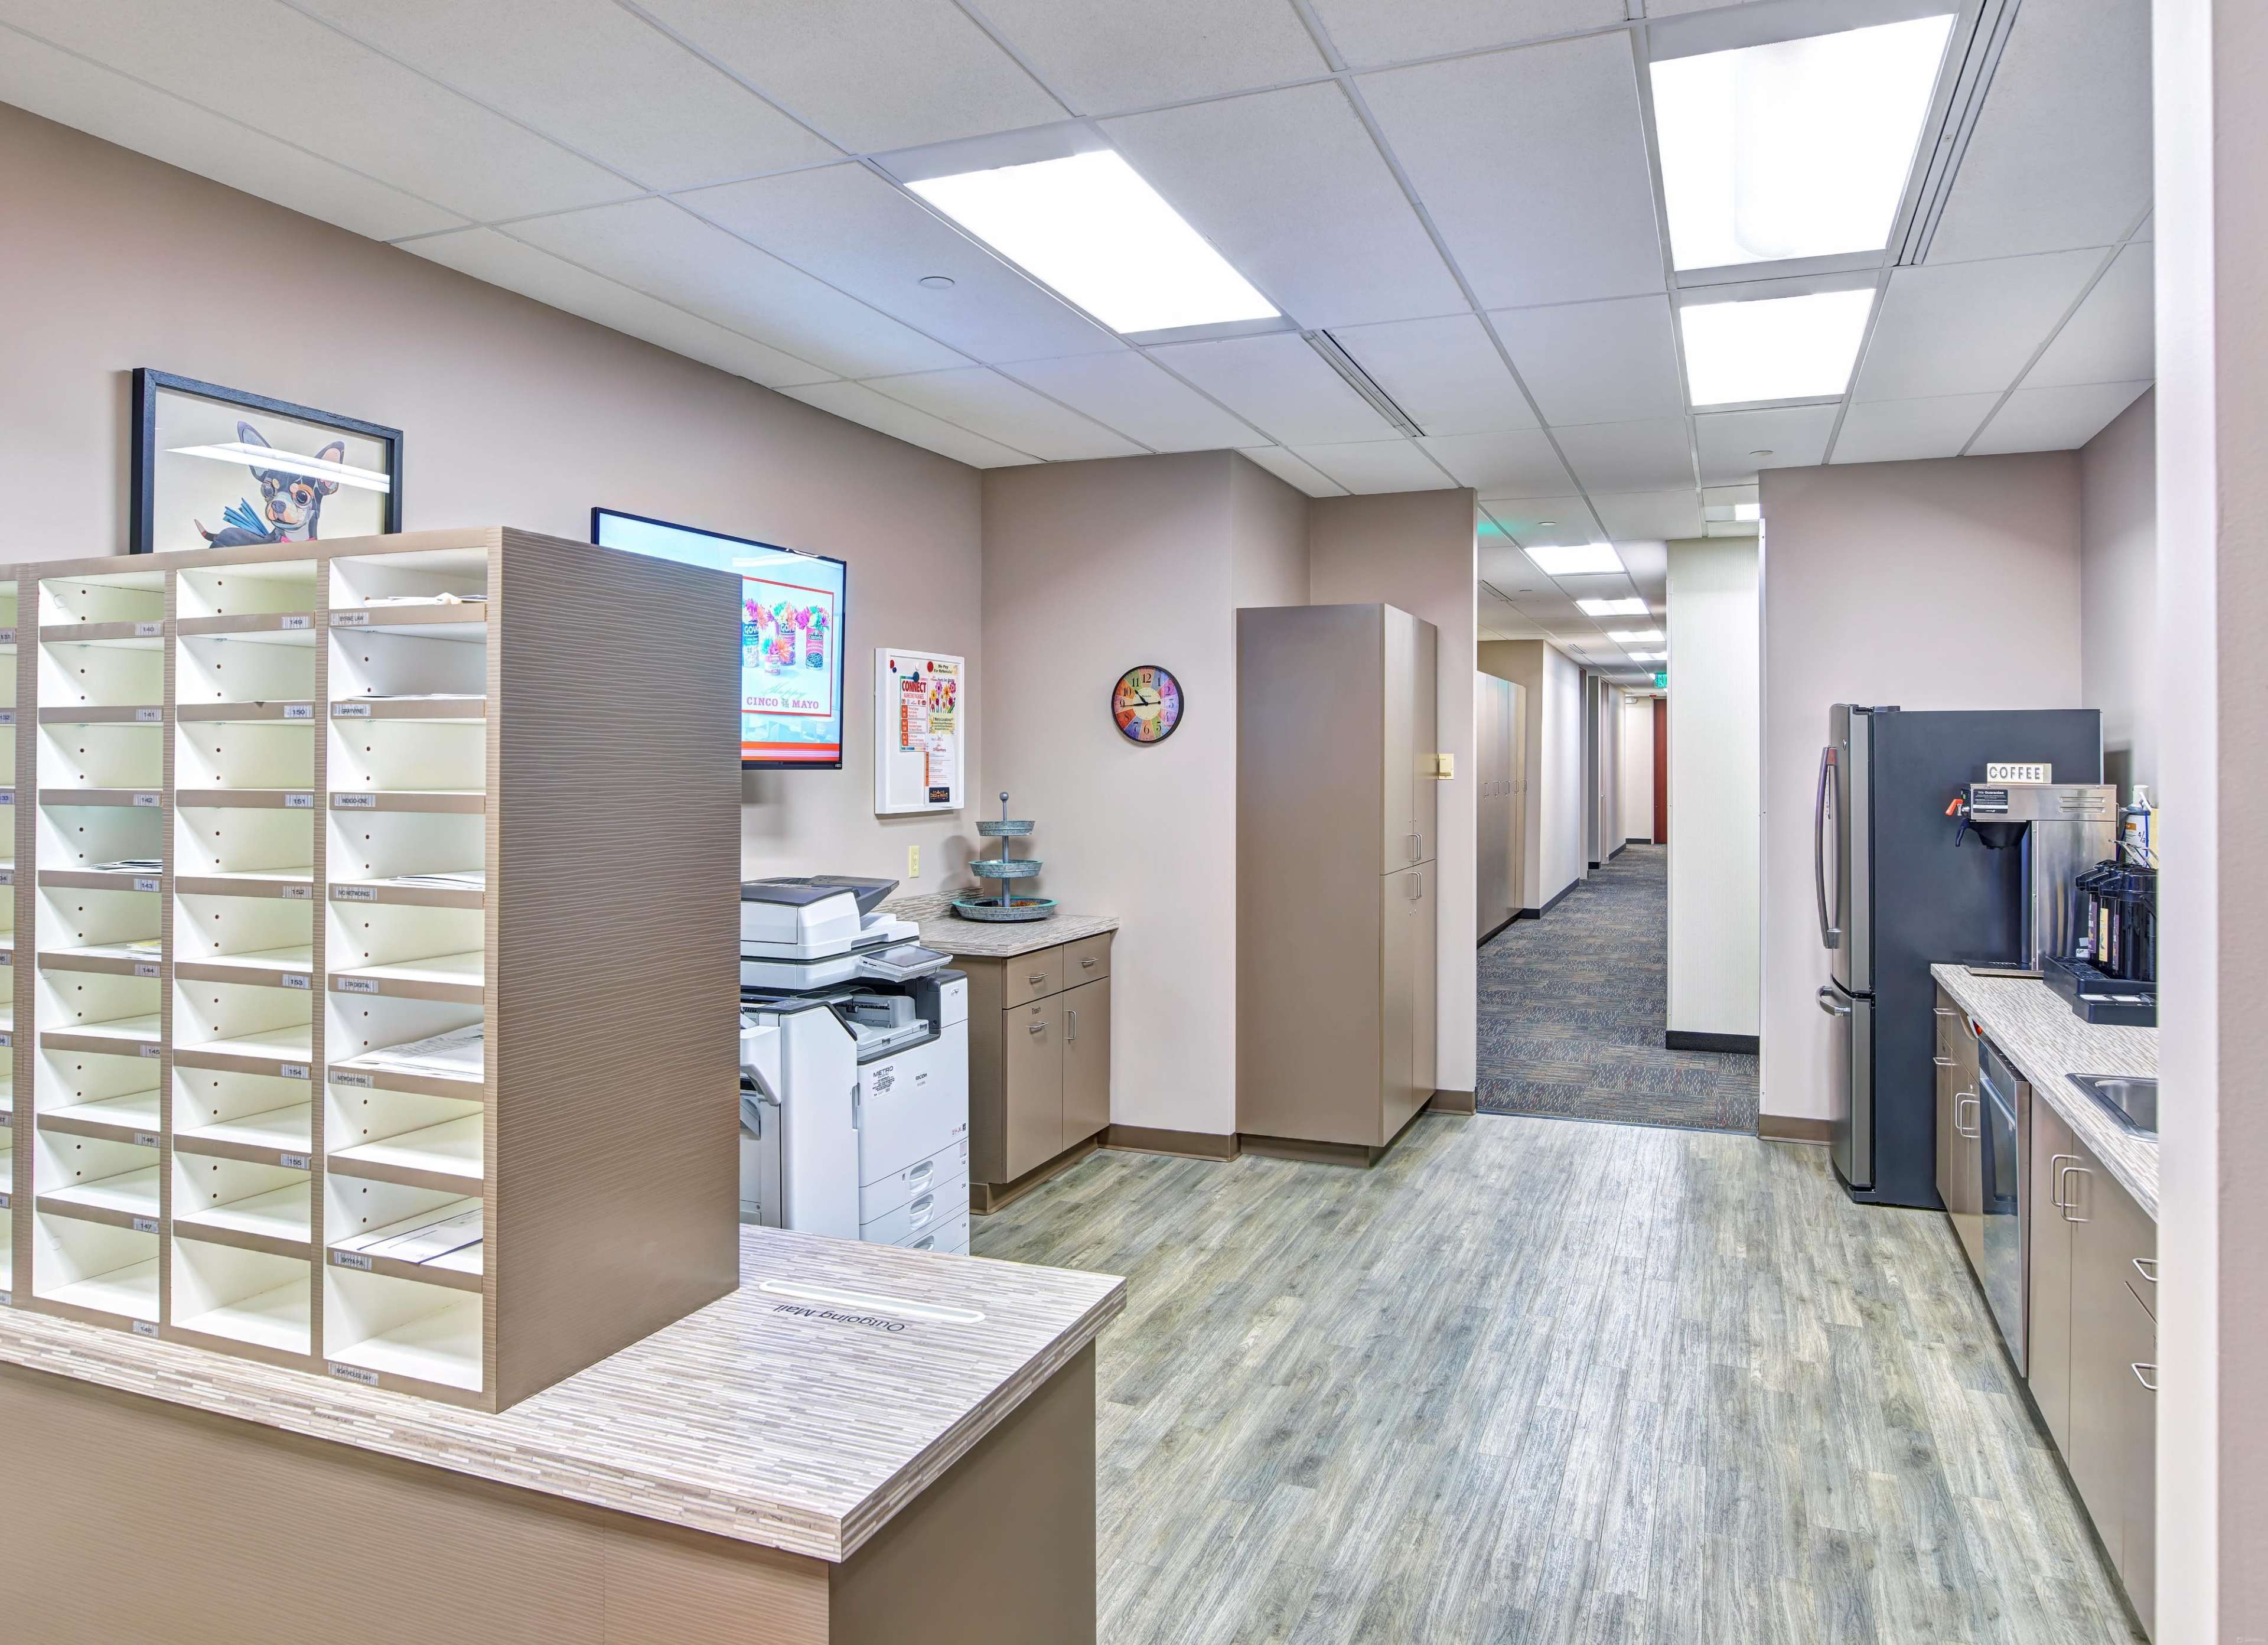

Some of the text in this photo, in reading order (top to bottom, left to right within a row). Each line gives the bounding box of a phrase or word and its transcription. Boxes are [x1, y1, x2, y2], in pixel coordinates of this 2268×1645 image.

[1132, 677, 1139, 687] 11
[1142, 673, 1152, 683] 12
[1158, 677, 1161, 686] 1
[902, 680, 926, 693] CONNECT
[1123, 687, 1132, 696] 10
[1165, 686, 1171, 696] 2
[747, 697, 778, 706] CINCO
[792, 699, 819, 709] MAYO
[1120, 699, 1125, 708] 9
[1133, 722, 1139, 732] 7
[1143, 725, 1149, 735] 6
[1156, 721, 1162, 732] 5
[1989, 766, 2040, 780] COFFEE
[873, 1066, 894, 1077] METRO
[773, 1304, 905, 1332] Outgoing Mail
